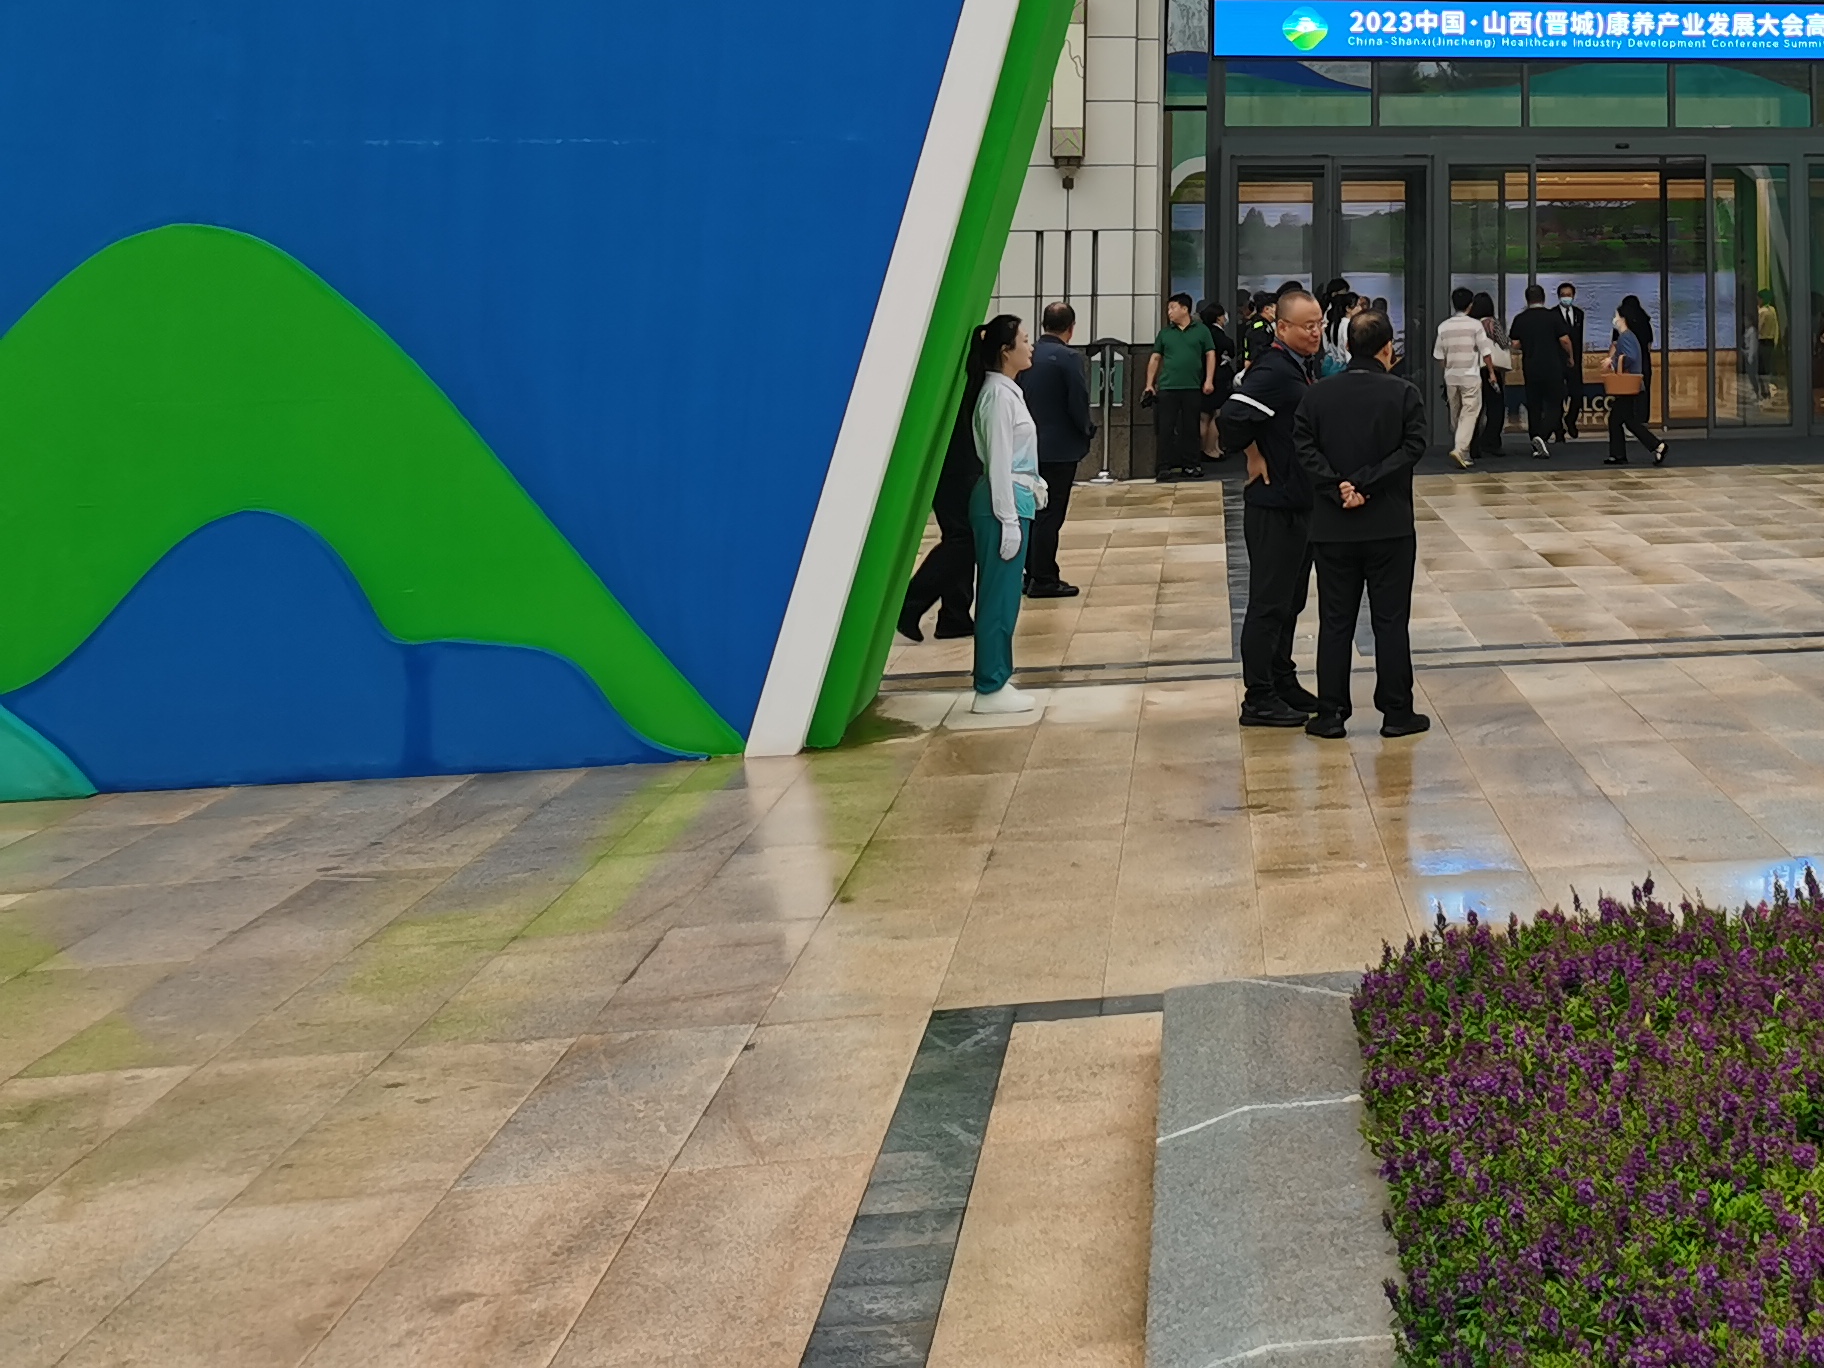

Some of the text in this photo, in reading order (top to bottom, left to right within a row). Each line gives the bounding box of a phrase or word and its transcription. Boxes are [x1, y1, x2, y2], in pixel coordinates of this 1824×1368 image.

[1501, 36, 1567, 48] Healthcare
[1572, 37, 1622, 50] Industry
[1627, 37, 1706, 50] Development
[1711, 38, 1779, 49] Conference
